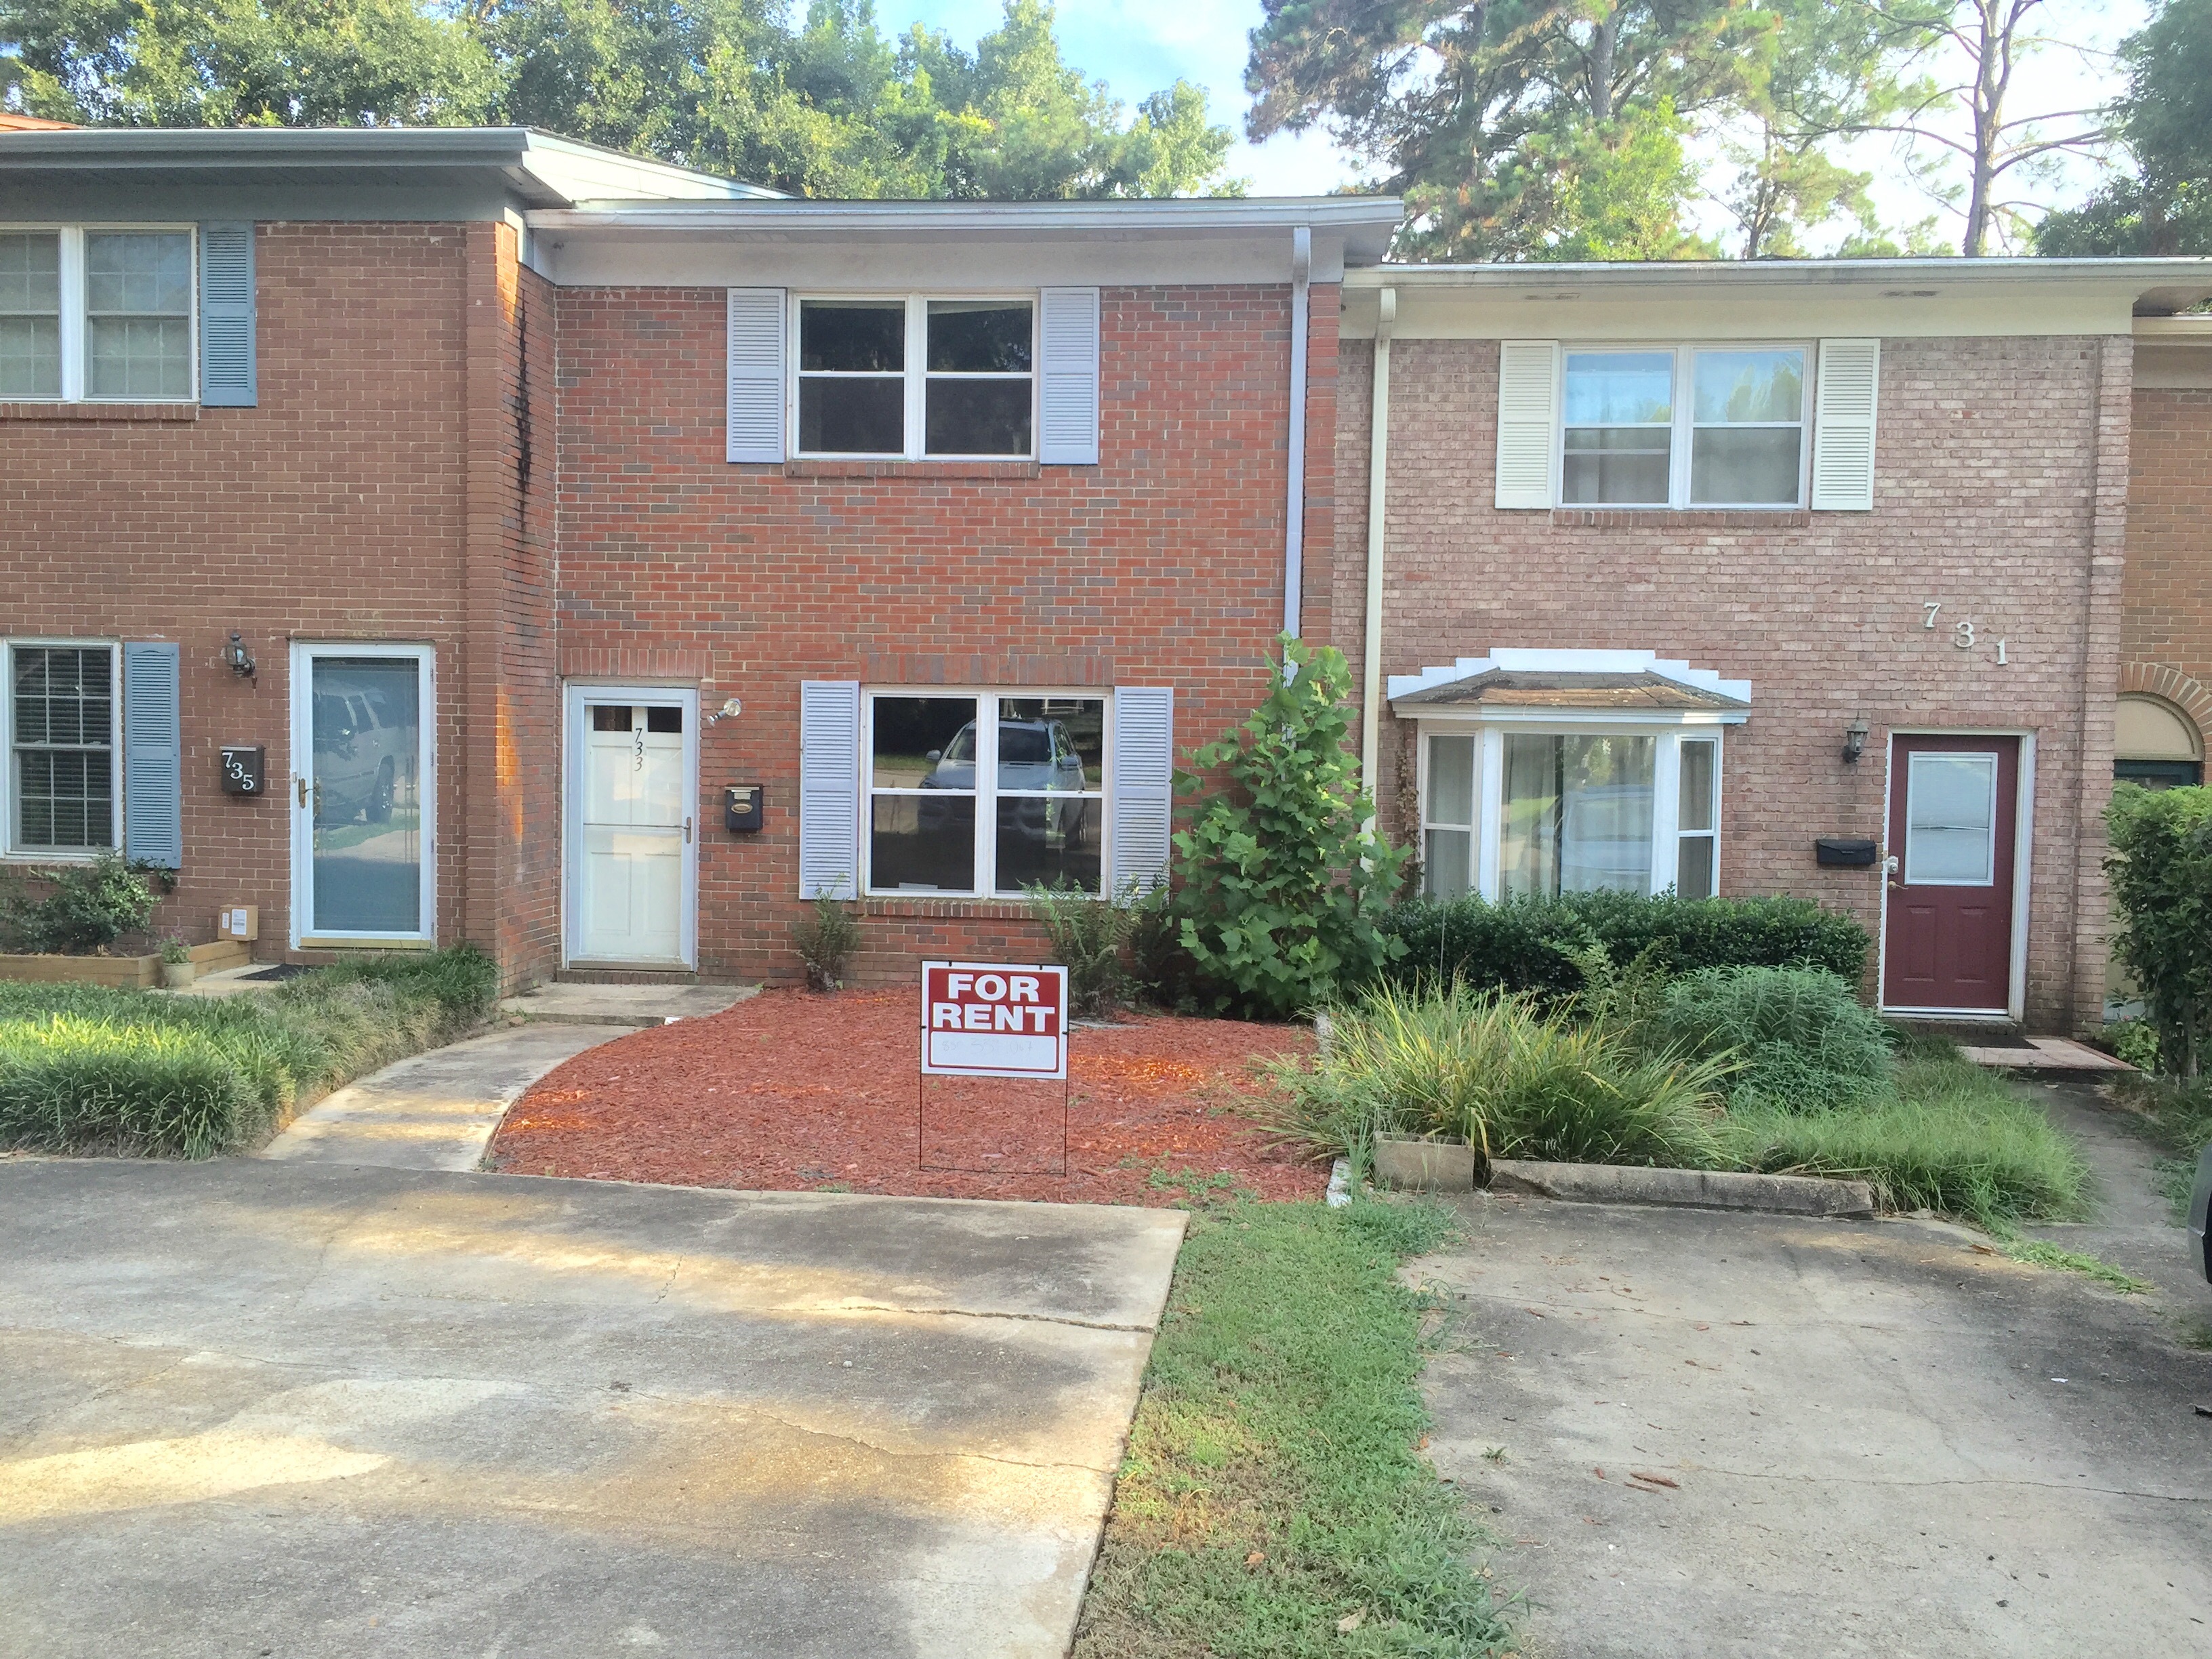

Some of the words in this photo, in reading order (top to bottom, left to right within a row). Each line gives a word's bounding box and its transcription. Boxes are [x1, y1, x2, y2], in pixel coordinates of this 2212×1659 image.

[1923, 602, 2008, 665] 731
[634, 727, 643, 771] 733
[222, 752, 254, 790] 735
[948, 973, 1040, 1002] FOR
[933, 1002, 1055, 1032] RENT
